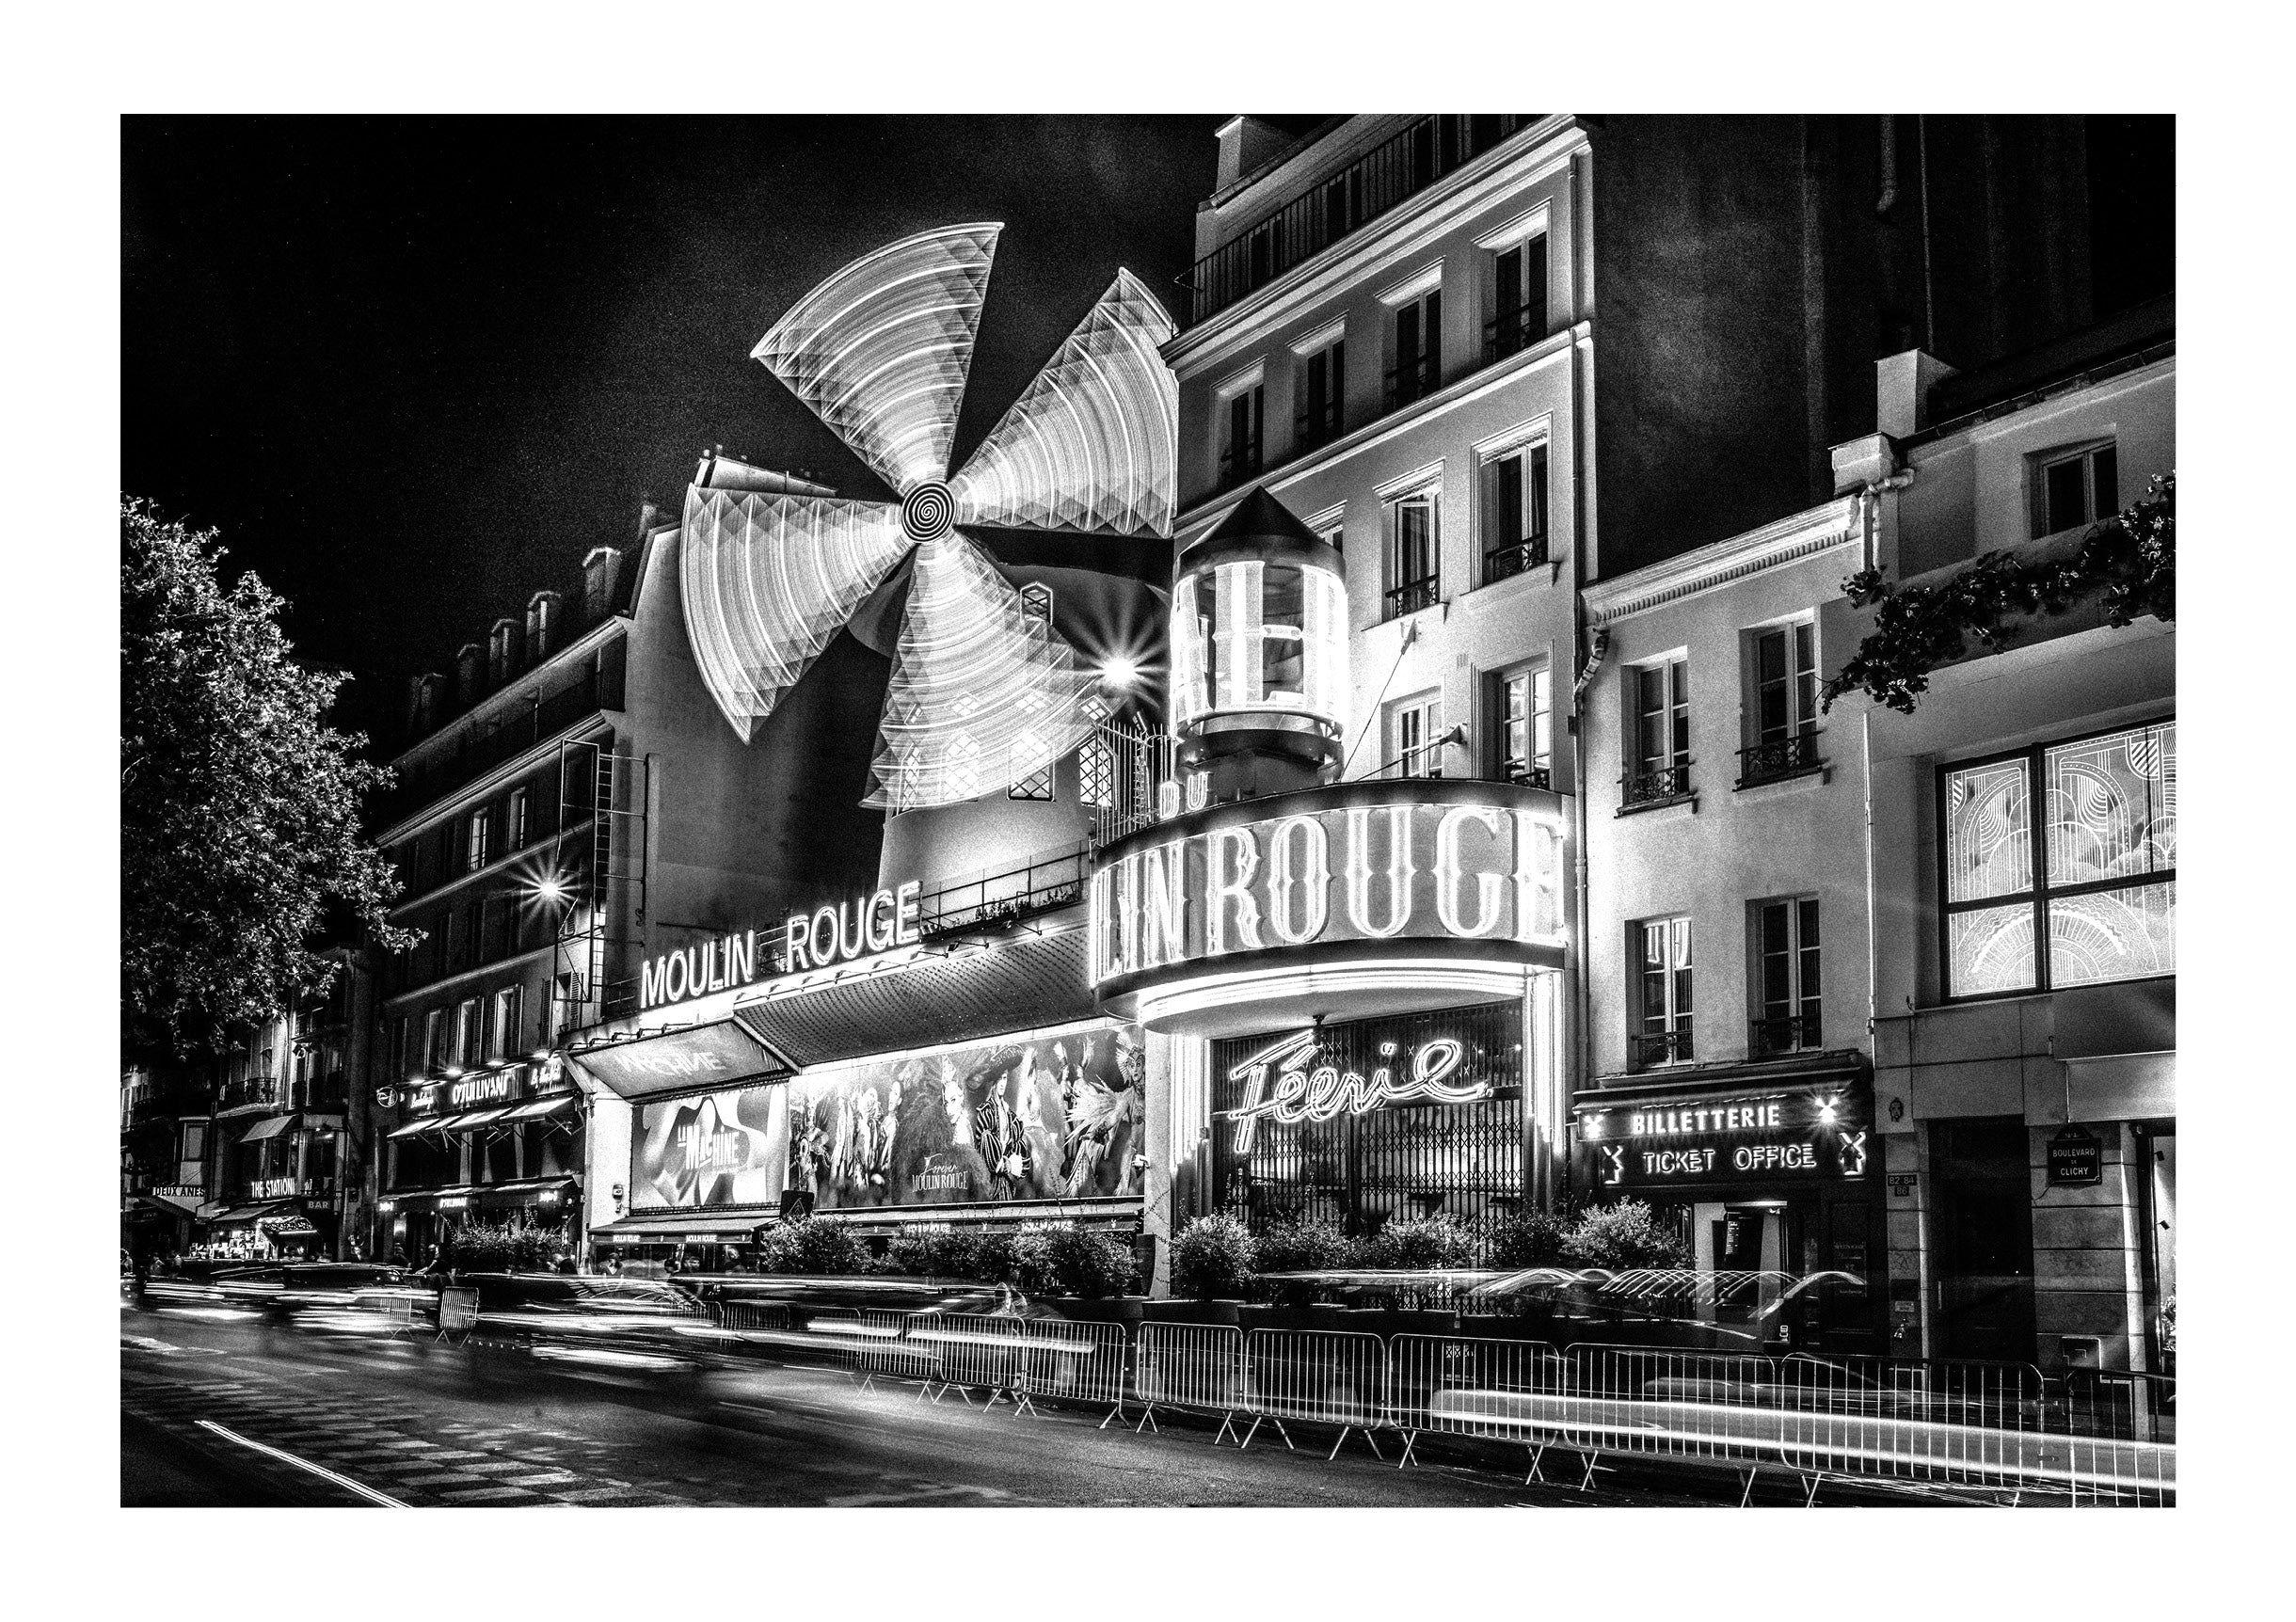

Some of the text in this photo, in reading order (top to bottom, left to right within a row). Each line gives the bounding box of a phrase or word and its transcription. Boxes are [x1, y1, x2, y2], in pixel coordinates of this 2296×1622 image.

[1159, 771, 1209, 819] DU
[1206, 803, 1565, 956] ROUGE
[640, 881, 920, 1008] MOULIN ROUGE
[1633, 1105, 1780, 1135] BILLETTERIE
[1642, 1143, 1817, 1174] TICKET OFFICE
[2052, 1148, 2096, 1157] BOULEVARD
[2060, 1167, 2089, 1176] CLICHY
[912, 1170, 968, 1192] MOULIN ROUGE
[1889, 1176, 1901, 1185] 82
[155, 1186, 177, 1197] DEUX
[250, 1181, 263, 1198] THE
[1896, 1186, 1907, 1195] 86
[307, 1201, 329, 1209] BAR
